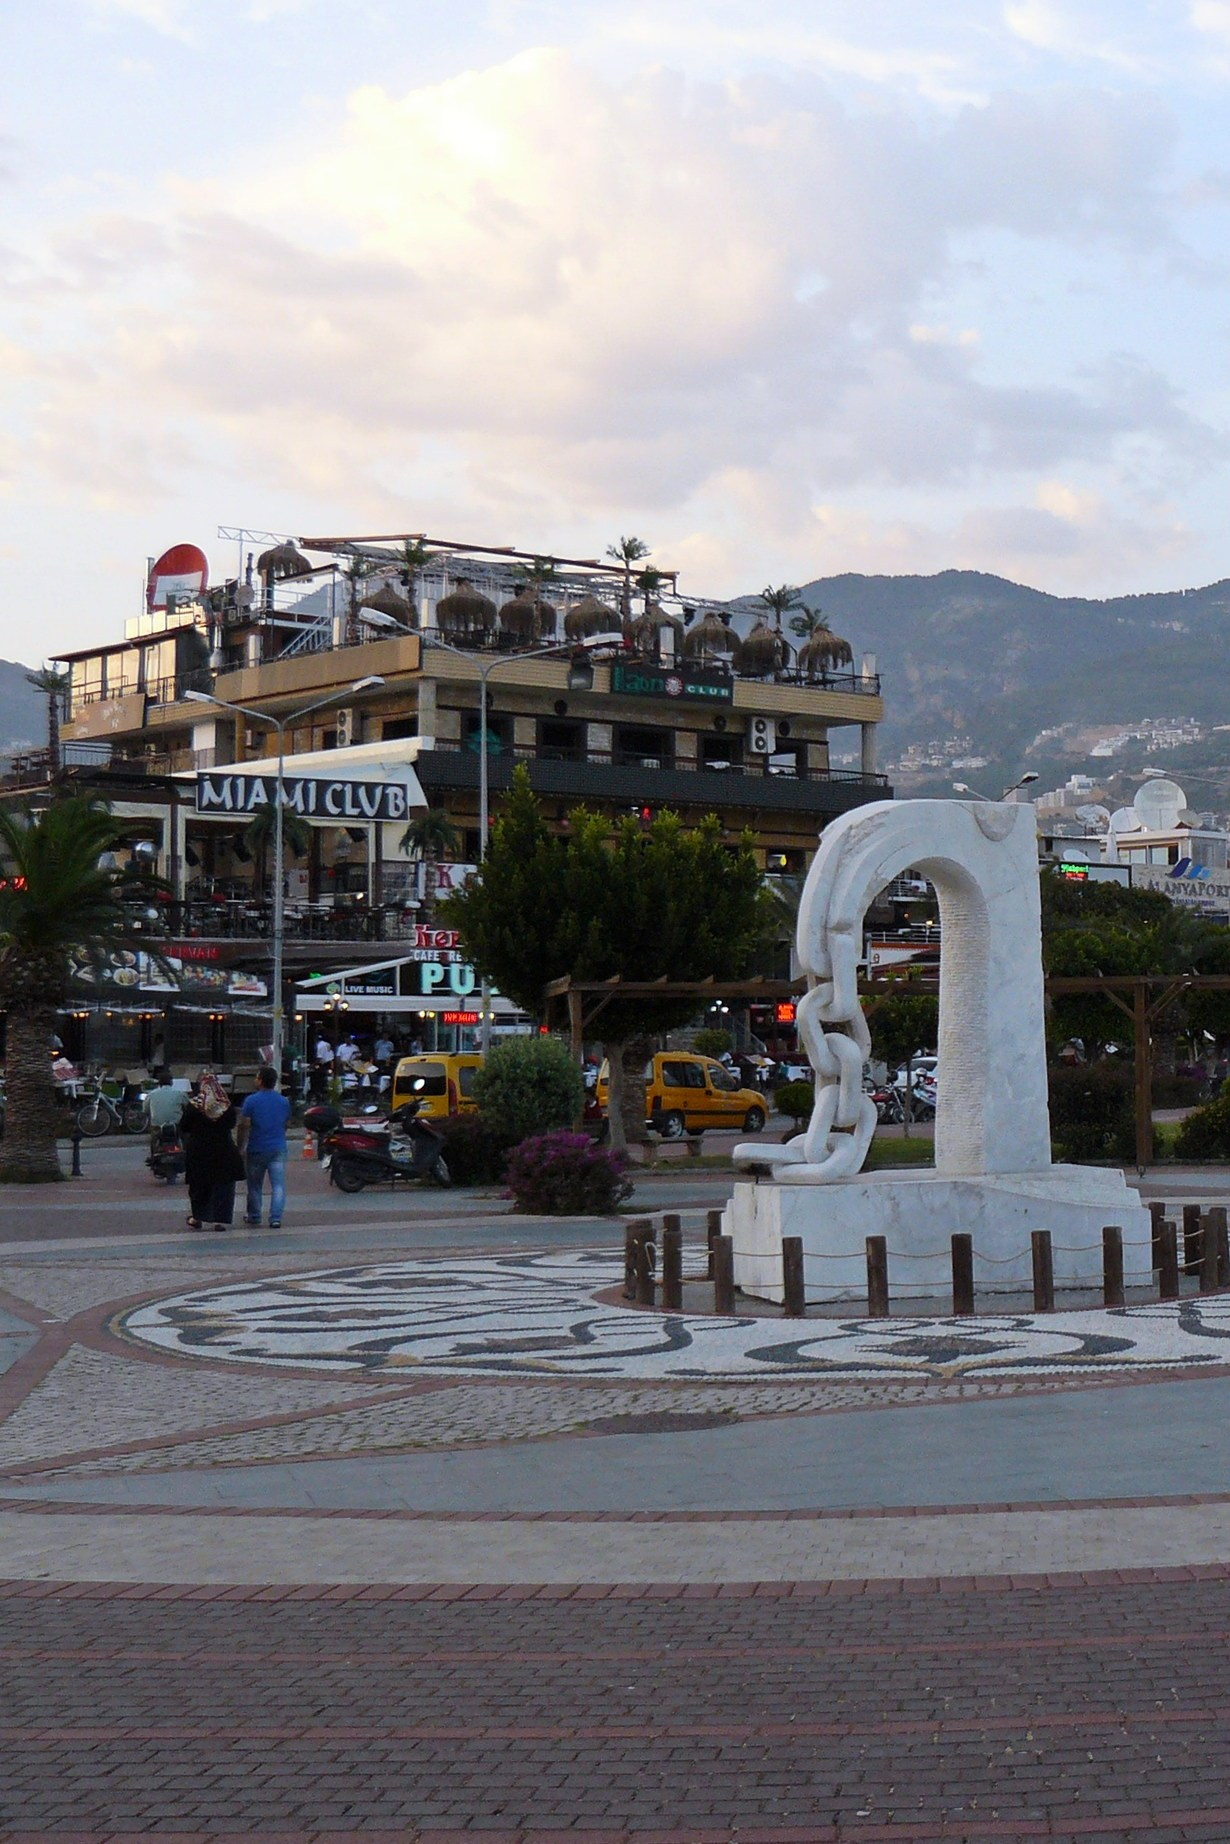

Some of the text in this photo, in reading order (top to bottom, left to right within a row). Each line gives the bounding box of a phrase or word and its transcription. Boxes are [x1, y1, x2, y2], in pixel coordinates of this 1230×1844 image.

[687, 685, 728, 696] CLUB
[202, 775, 317, 813] MIAMI
[413, 950, 440, 961] CAFE
[345, 985, 394, 994] LIVE MUSIC
